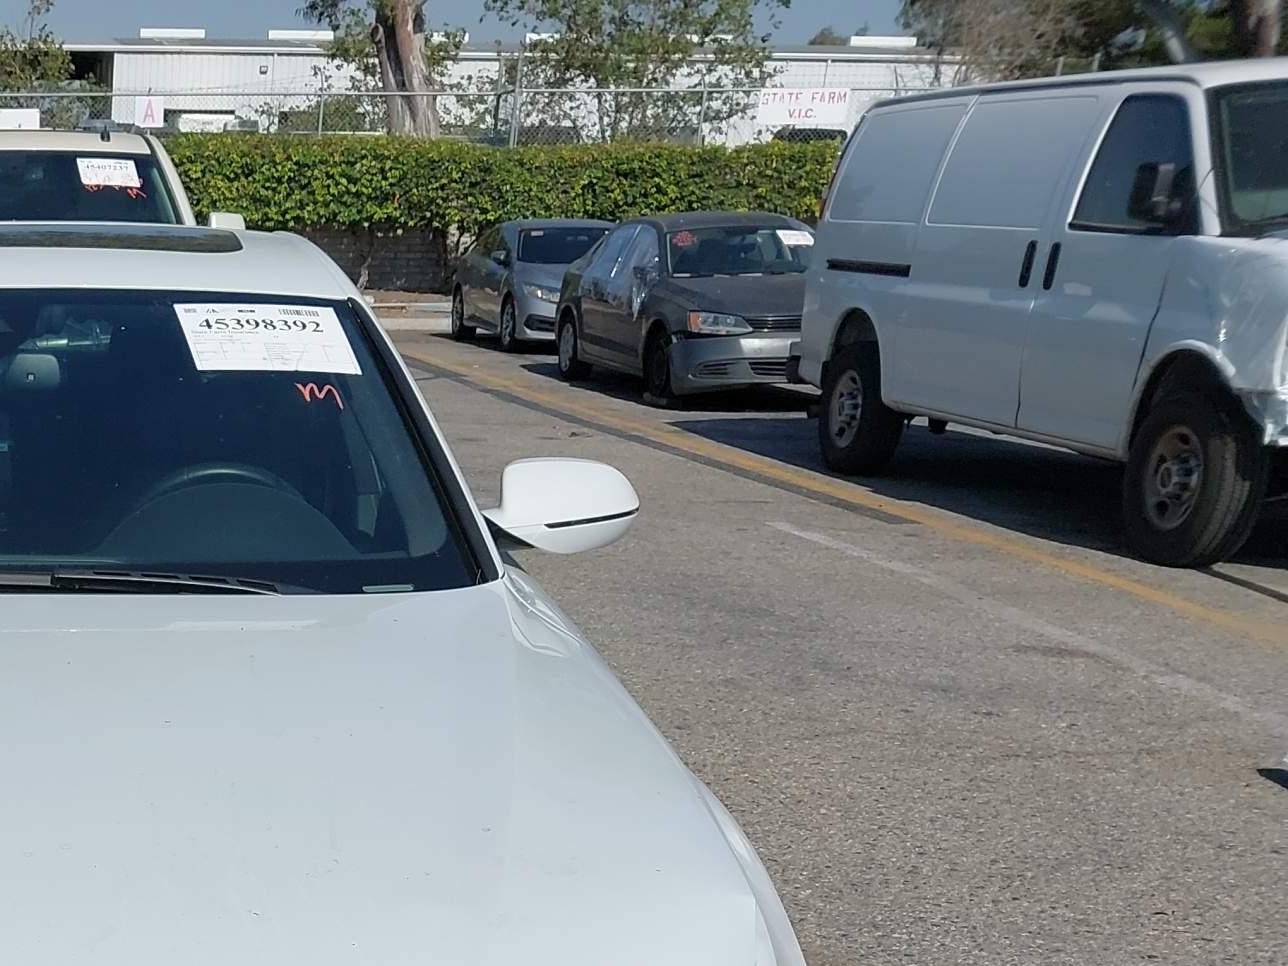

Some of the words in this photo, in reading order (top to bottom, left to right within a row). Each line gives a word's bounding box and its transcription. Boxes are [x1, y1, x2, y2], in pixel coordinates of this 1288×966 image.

[761, 92, 803, 105] STATE
[811, 91, 847, 105] FARM
[142, 98, 156, 123] A
[788, 108, 817, 119] V.I.C.
[199, 318, 324, 333] 45398392
